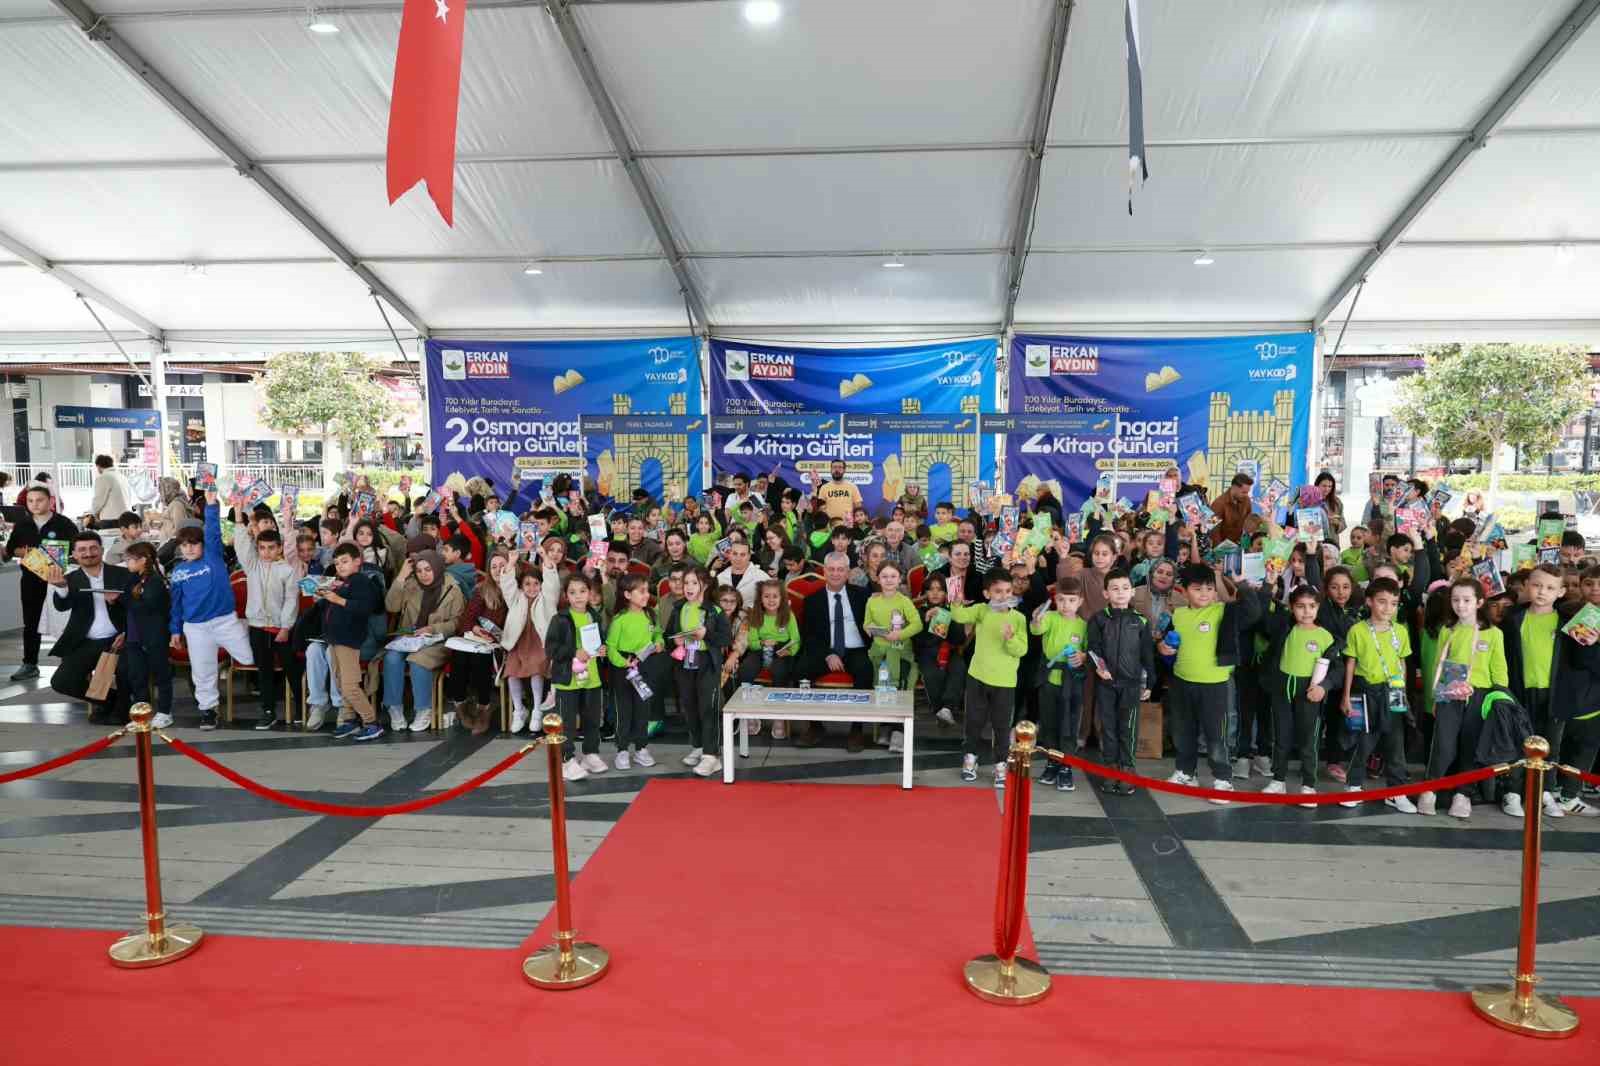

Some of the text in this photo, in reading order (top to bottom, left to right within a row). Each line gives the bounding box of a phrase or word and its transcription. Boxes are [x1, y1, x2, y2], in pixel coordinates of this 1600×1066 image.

[466, 352, 508, 362] ERKAN
[750, 353, 794, 364] ERKAN
[1052, 347, 1098, 358] ERKAN
[470, 363, 508, 374] AYDIN
[752, 364, 792, 376] AYDIN
[1054, 359, 1096, 370] AYDIN
[1119, 416, 1178, 440] ngazi
[445, 417, 580, 452] 2. Osmangaz
[474, 436, 587, 456] Kitap Günleri
[754, 440, 873, 459] Kitap Günleri
[1053, 436, 1178, 458] Kitap Günleri
